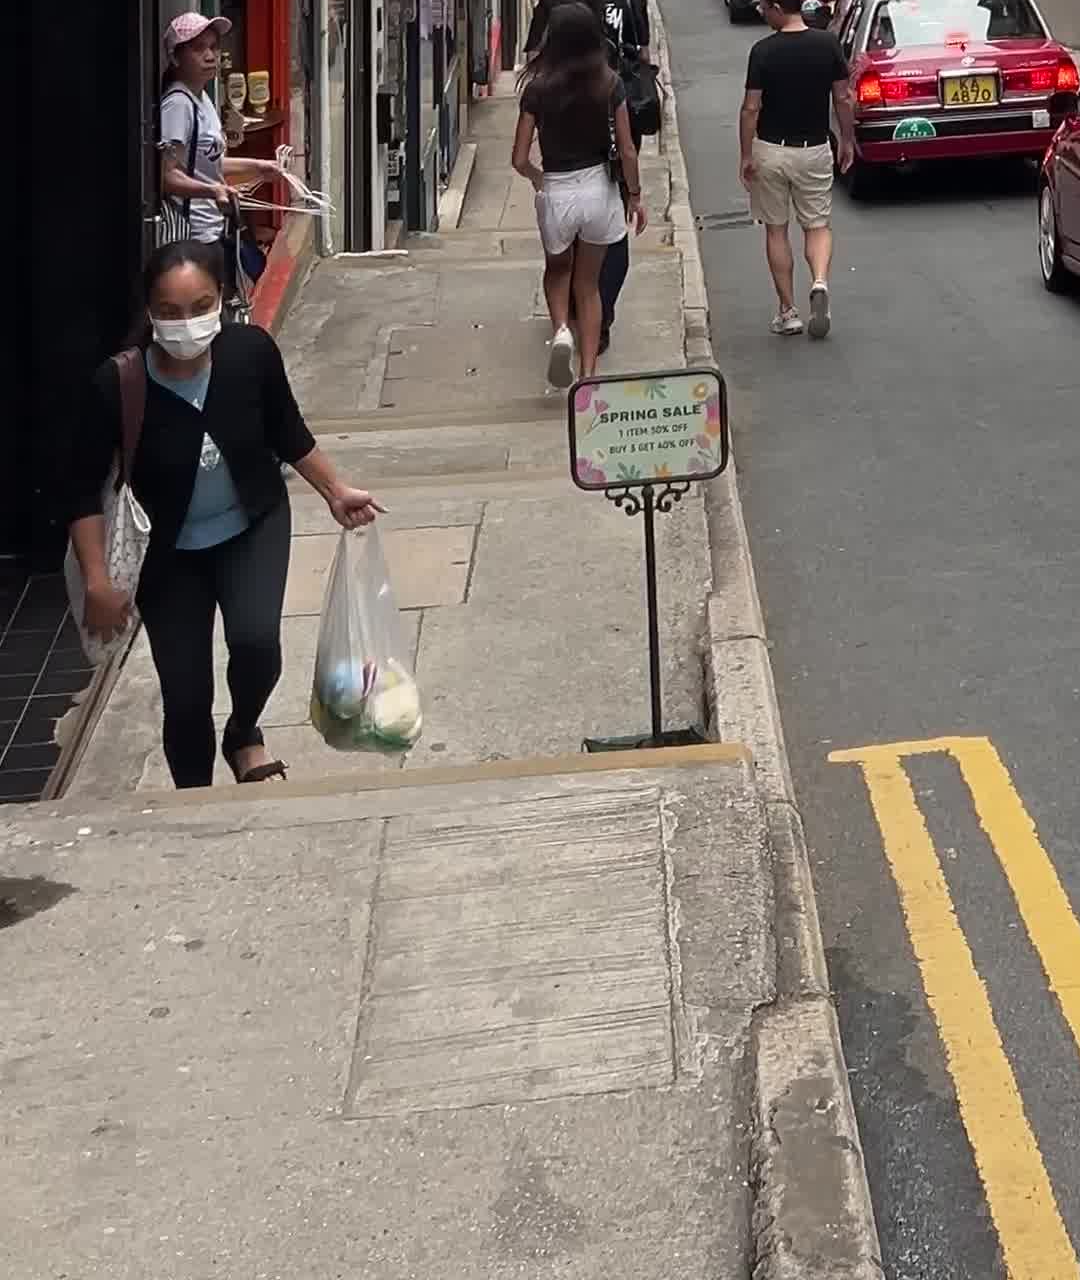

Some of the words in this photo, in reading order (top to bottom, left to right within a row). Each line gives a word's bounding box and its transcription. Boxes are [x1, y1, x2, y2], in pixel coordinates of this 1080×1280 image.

[959, 76, 979, 91] KA
[951, 89, 991, 102] 4870
[600, 407, 658, 423] SPRING
[663, 404, 702, 418] SALE
[626, 427, 648, 437] ITEM
[672, 423, 688, 433] OFF
[609, 445, 627, 454] BUY
[638, 442, 655, 452] GET
[679, 439, 696, 448] OFF
